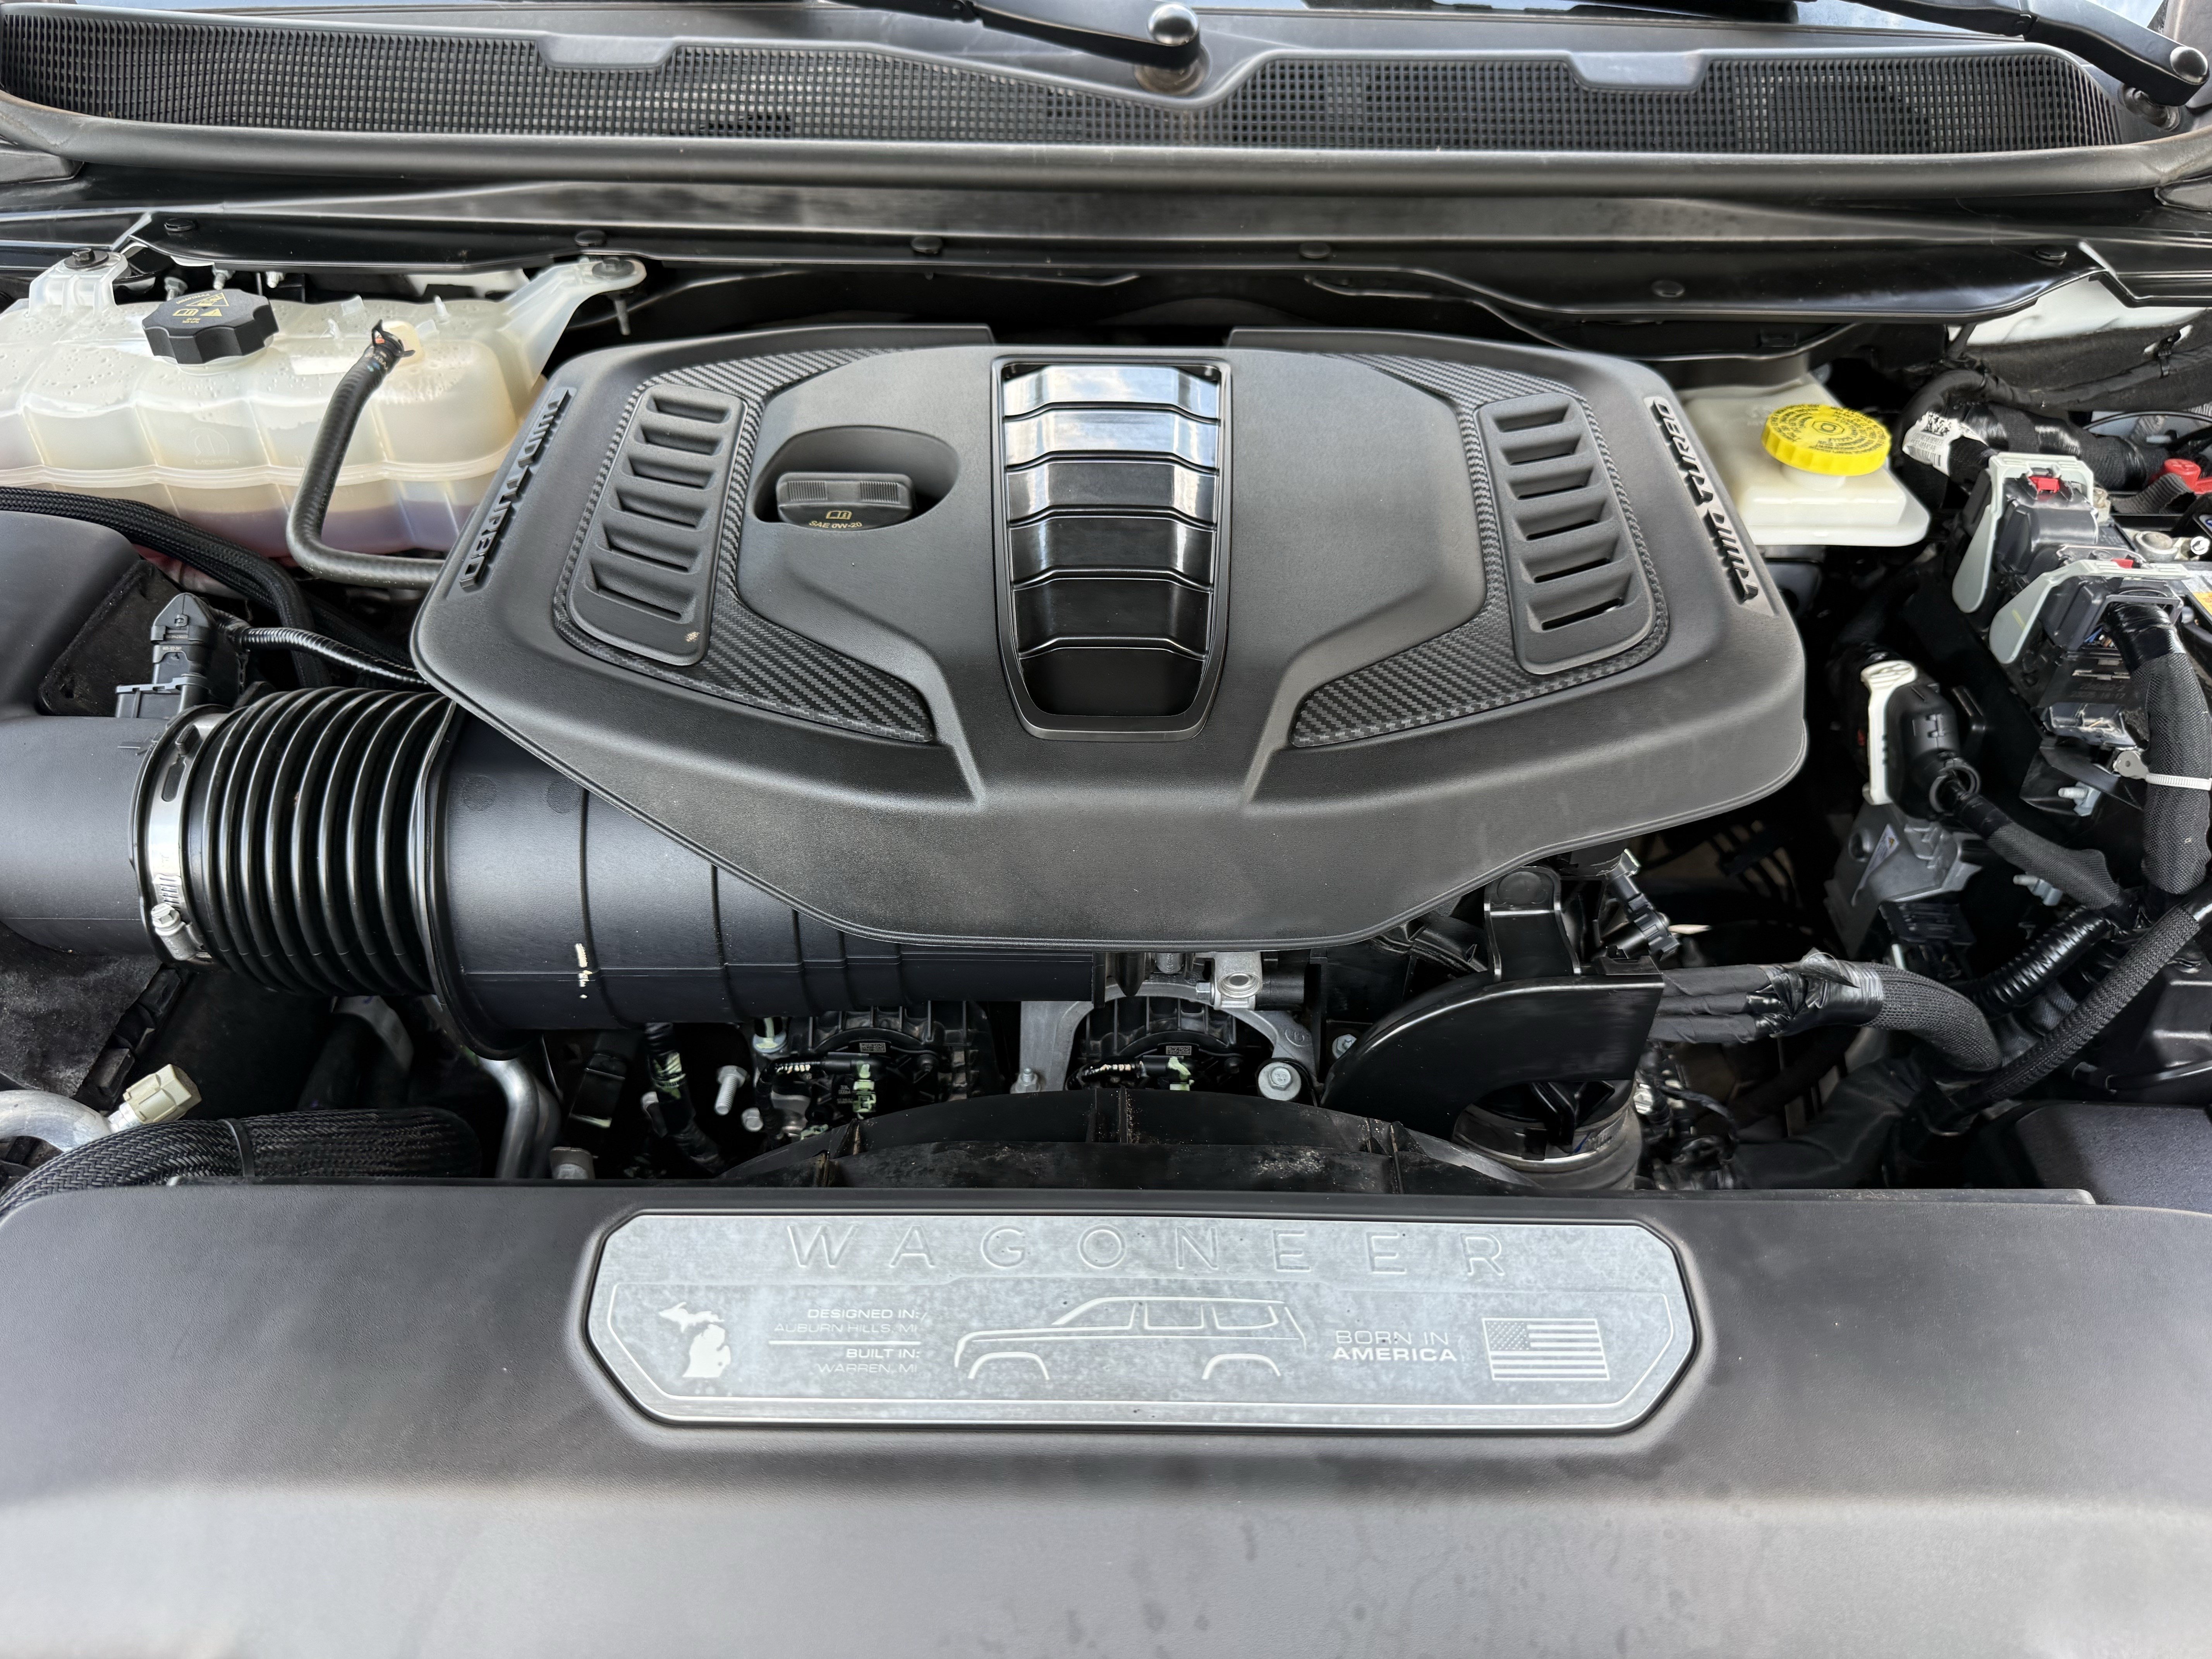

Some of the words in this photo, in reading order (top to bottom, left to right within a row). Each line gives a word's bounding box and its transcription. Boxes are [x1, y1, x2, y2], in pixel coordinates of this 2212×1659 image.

[518, 389, 572, 468] TWIN
[1653, 399, 1713, 504] TURBO
[459, 465, 529, 588] TURBO
[1706, 508, 1759, 600] TWIN
[787, 1224, 1505, 1276] WAGONEER
[808, 1309, 893, 1318] DESIGNED
[898, 1309, 919, 1318] IN:
[775, 1323, 843, 1333] AUBURN
[899, 1324, 917, 1333] MI
[1336, 1330, 1412, 1345] BORN
[1424, 1331, 1449, 1345] IN
[847, 1348, 894, 1358] BUILT
[899, 1349, 920, 1358] IN:
[1333, 1346, 1457, 1362] AMERICA
[899, 1364, 917, 1373] MI
